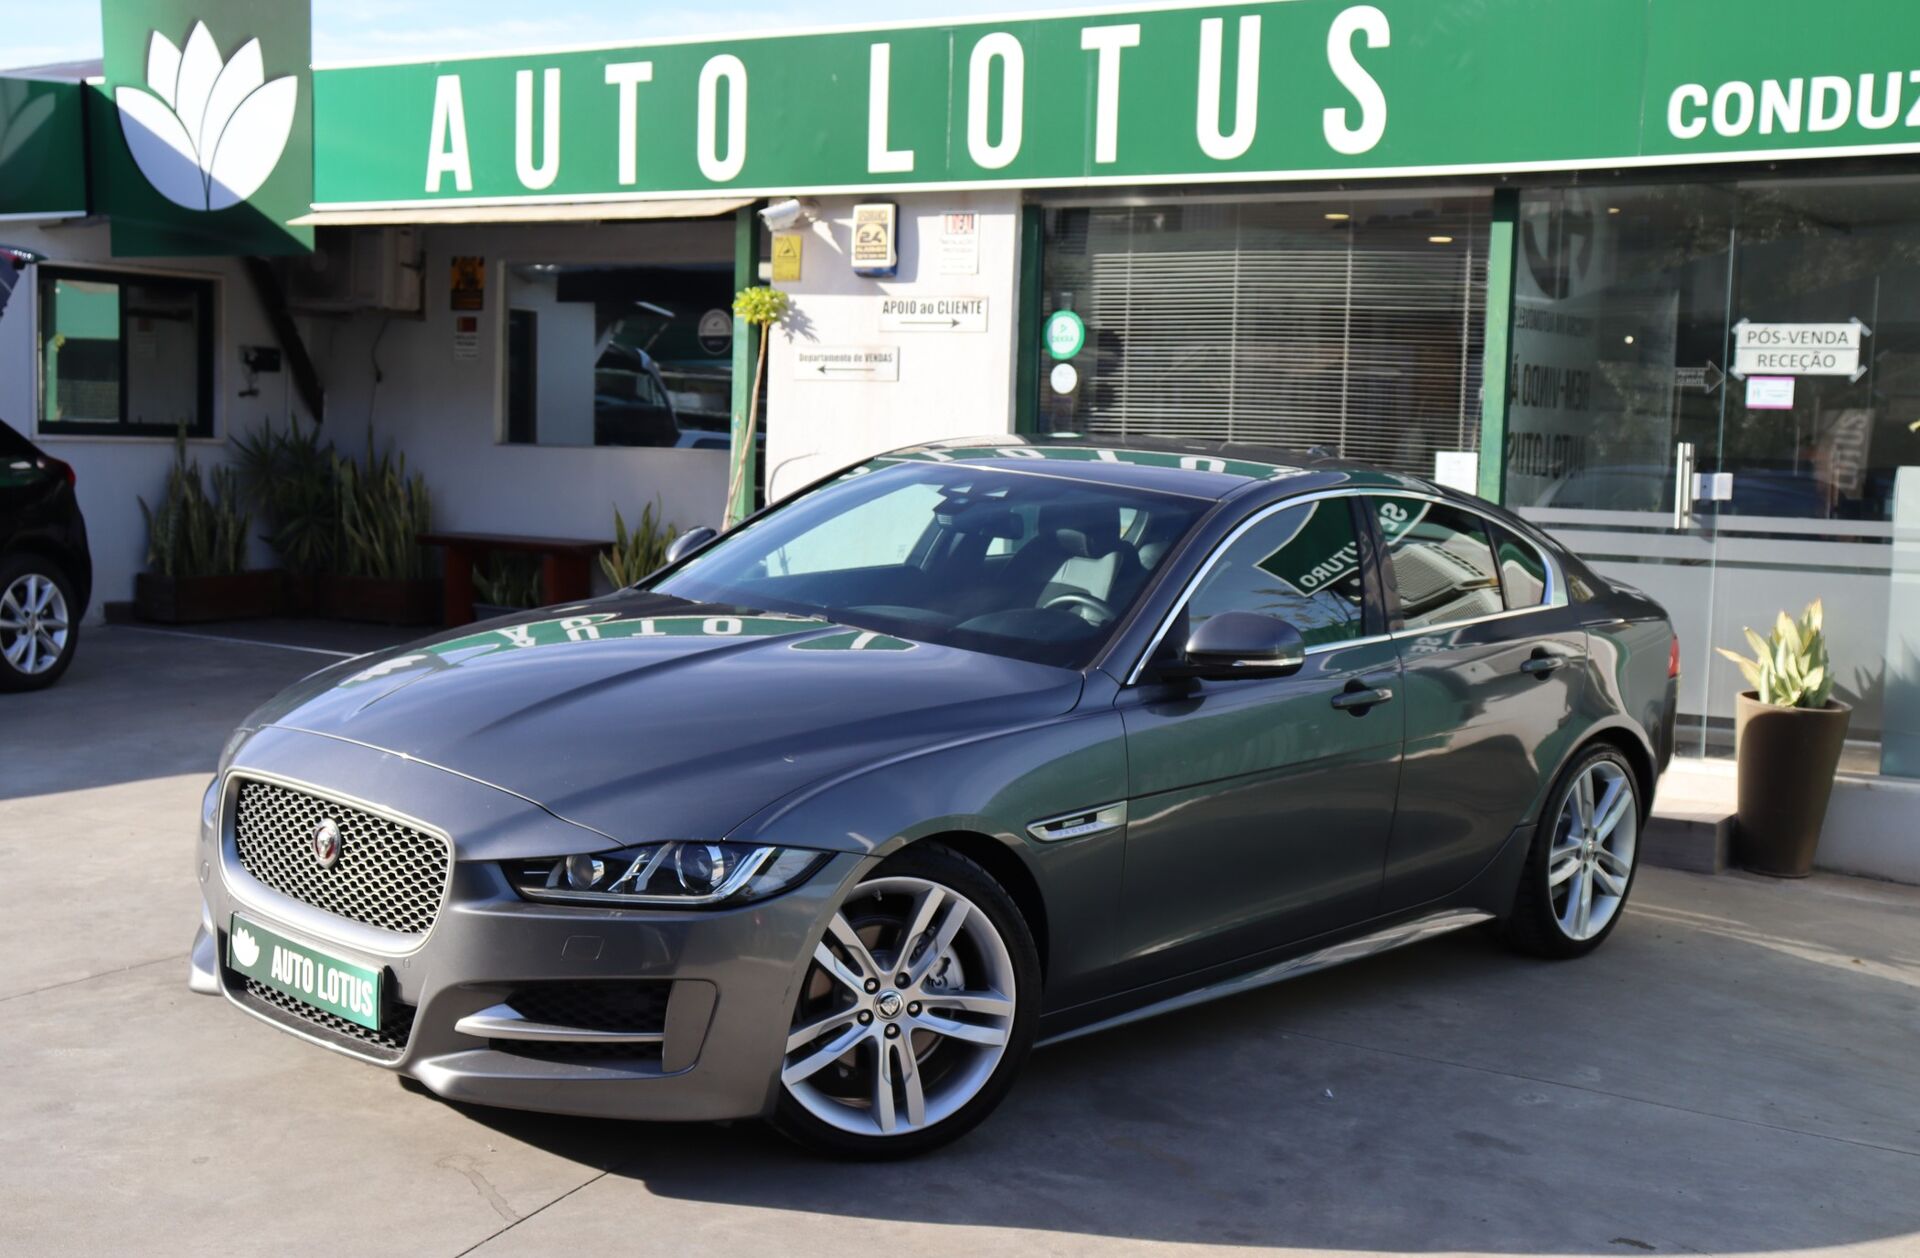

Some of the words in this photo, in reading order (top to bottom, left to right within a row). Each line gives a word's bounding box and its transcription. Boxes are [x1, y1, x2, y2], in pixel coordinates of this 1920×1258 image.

[425, 53, 748, 193] AUTO
[868, 4, 1391, 173] LOTUS
[882, 300, 917, 315] APOIO
[919, 302, 934, 315] ao
[937, 299, 982, 315] CLIENTE
[1747, 327, 1849, 345] PÓS-VENDA
[799, 353, 852, 363] Departamento
[864, 353, 893, 363] VENDAS
[1757, 350, 1836, 371] RECEÇÃO
[270, 944, 315, 995] AUTO
[317, 962, 374, 1018] LOTUS
